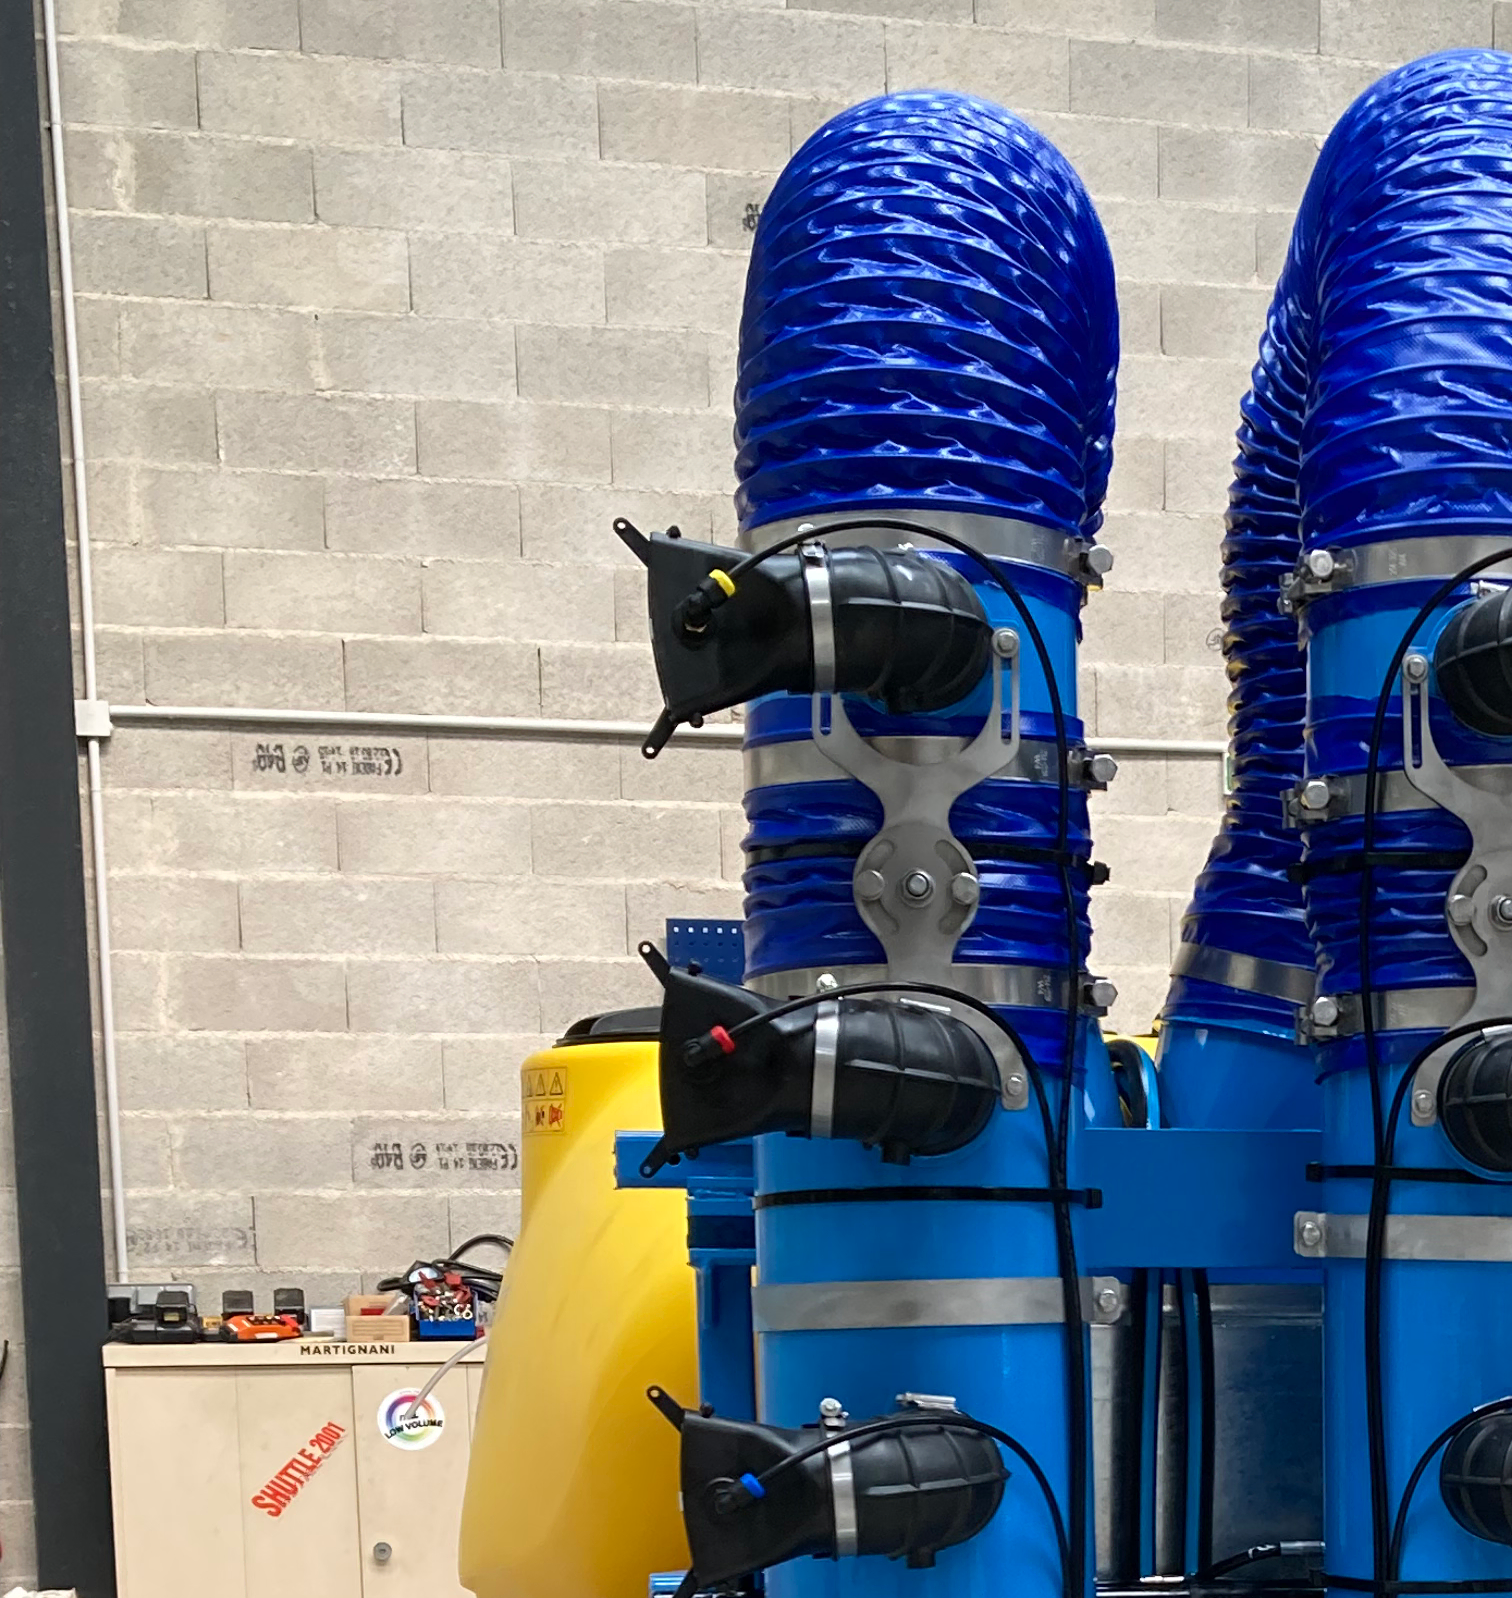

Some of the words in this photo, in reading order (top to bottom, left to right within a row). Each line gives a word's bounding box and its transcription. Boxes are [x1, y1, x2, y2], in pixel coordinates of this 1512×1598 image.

[300, 1344, 395, 1355] MARTIGNANI
[384, 1424, 404, 1439] LOW
[405, 1419, 443, 1430] VOLUME
[251, 1448, 322, 1517] SHUTTLE
[309, 1421, 346, 1454] 2001
